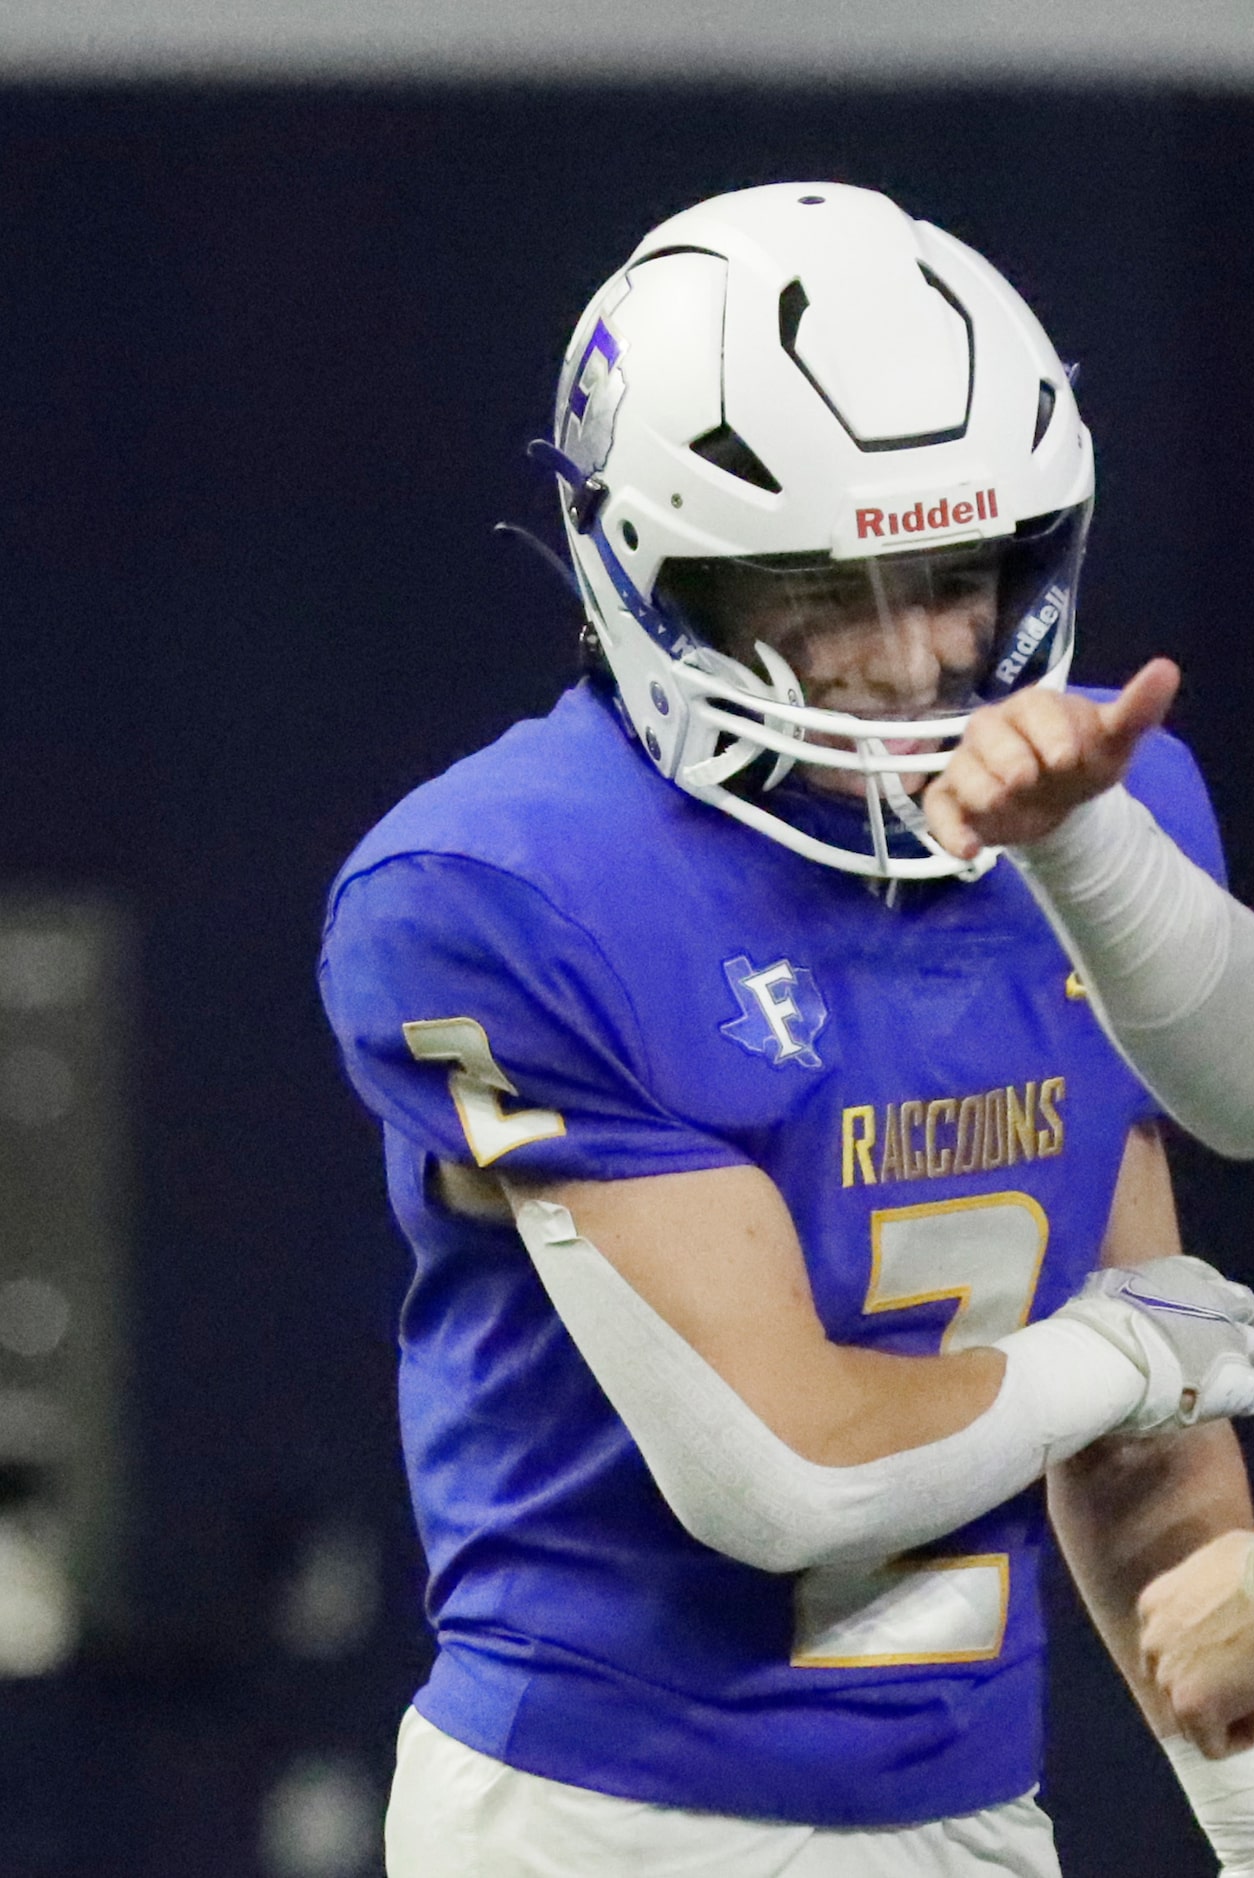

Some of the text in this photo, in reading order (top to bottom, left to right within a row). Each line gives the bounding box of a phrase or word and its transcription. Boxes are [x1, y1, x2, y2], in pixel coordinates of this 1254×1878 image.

[855, 488, 998, 539] Riddell
[739, 958, 802, 1058] F
[402, 1016, 567, 1168] 2
[842, 1076, 1065, 1188] RACCOONS
